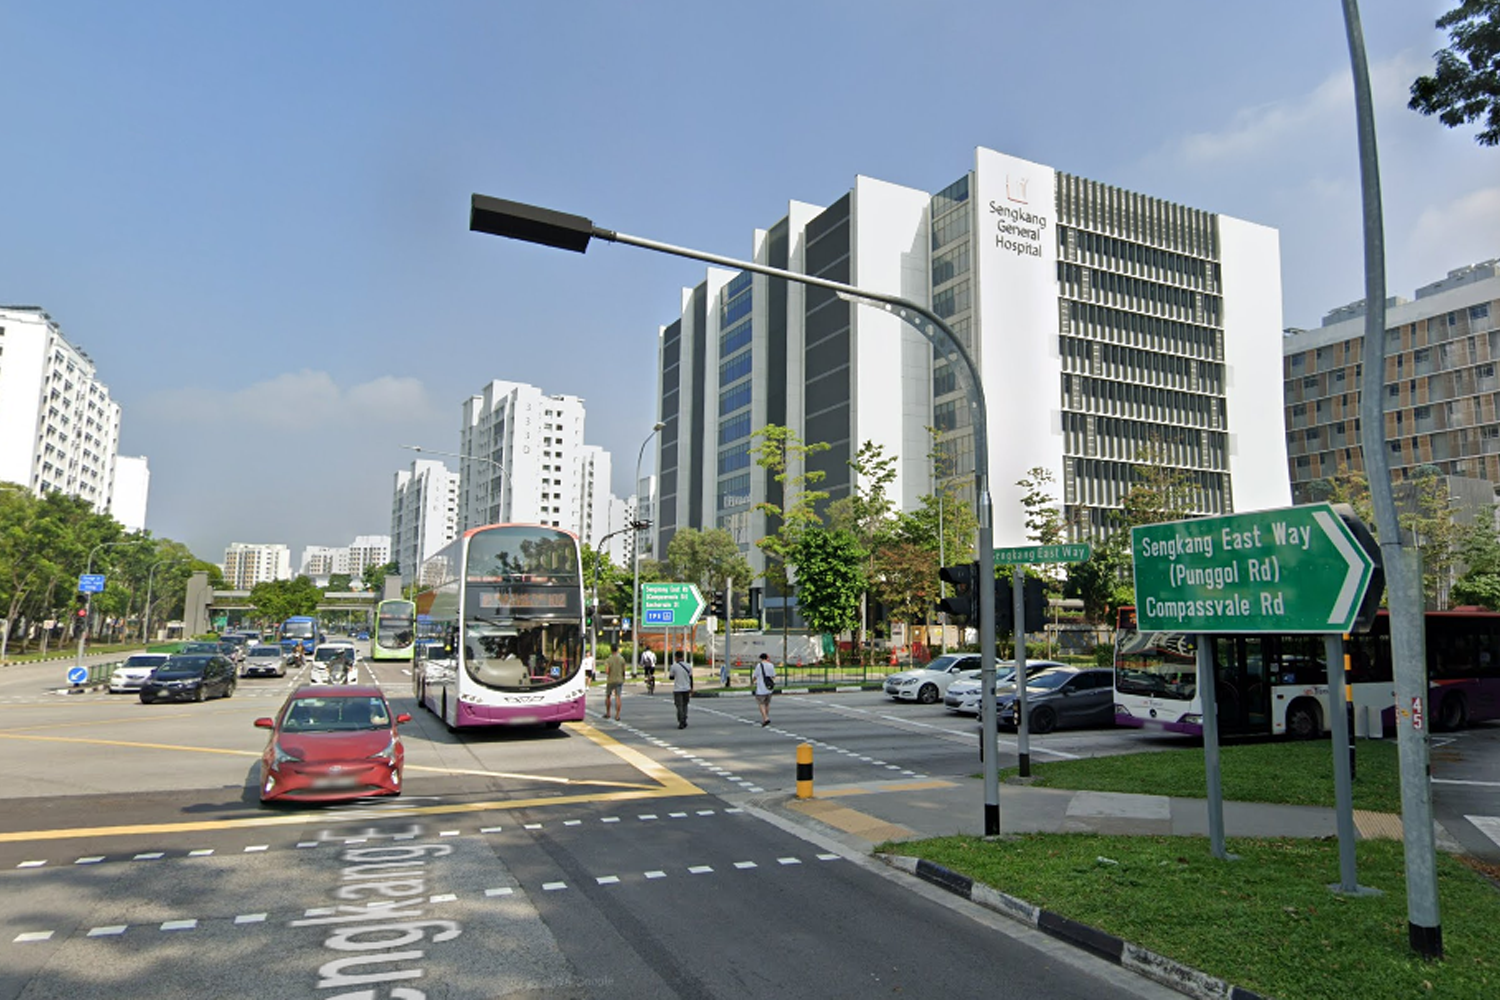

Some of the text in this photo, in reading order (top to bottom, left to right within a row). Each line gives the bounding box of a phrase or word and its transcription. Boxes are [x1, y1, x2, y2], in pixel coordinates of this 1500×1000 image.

[989, 200, 1047, 230] Sengkang
[997, 219, 1041, 241] General
[995, 234, 1042, 258] Hospital
[993, 546, 1085, 563] engkang East Way
[1142, 521, 1311, 561] Sengkang East Way
[1169, 556, 1280, 590] (Punggol Rd)
[1145, 593, 1250, 622] Compassvale
[1260, 591, 1285, 616] Rd
